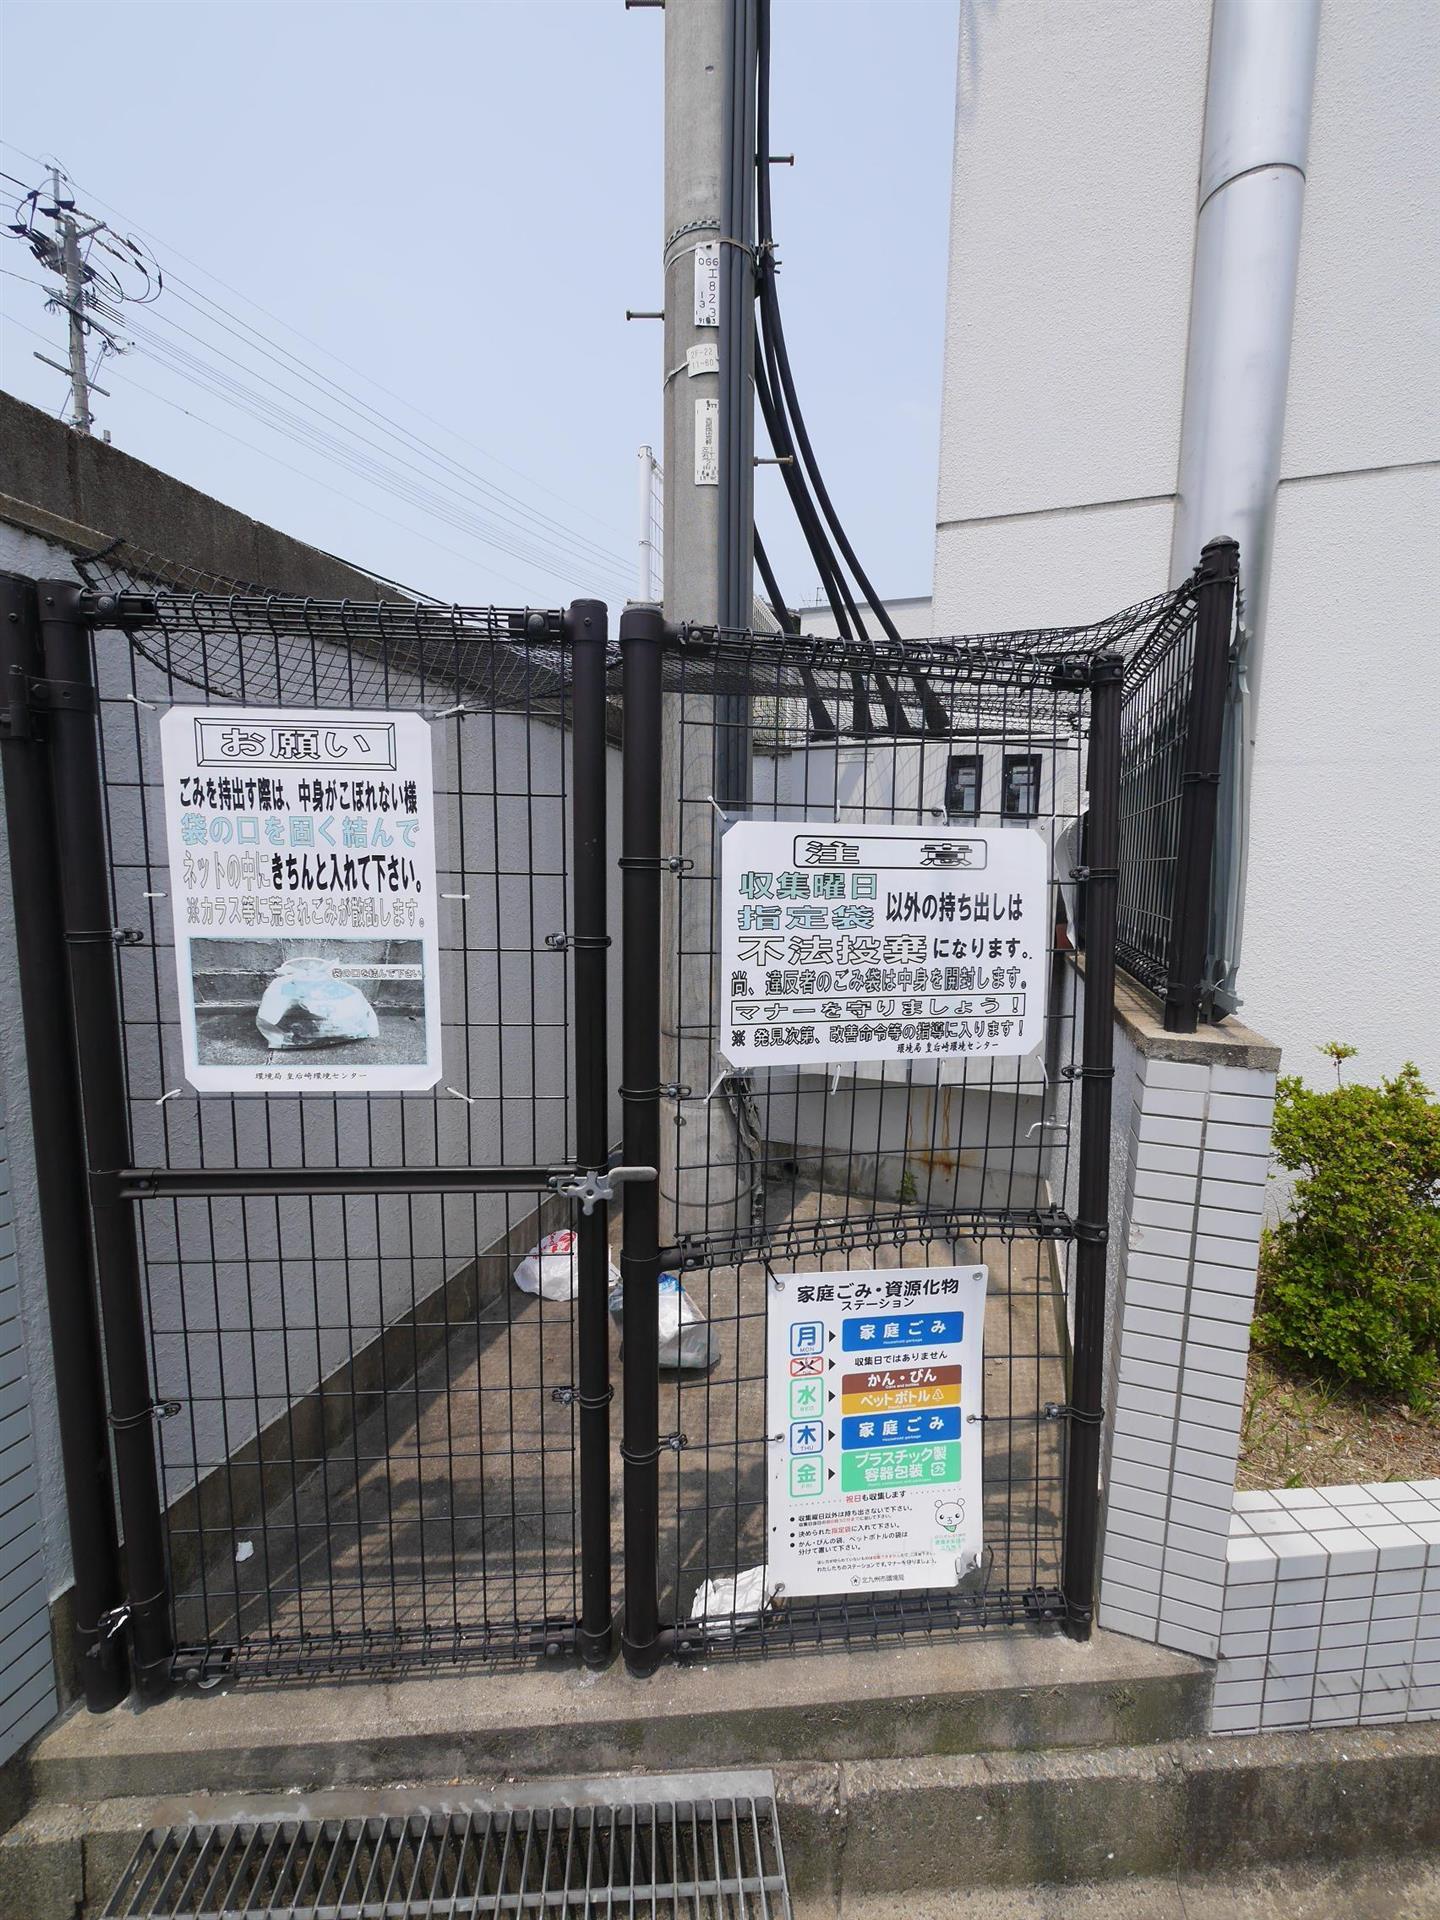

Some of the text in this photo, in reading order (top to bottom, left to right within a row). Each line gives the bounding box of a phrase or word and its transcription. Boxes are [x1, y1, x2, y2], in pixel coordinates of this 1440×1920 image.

[699, 258, 718, 266] 066
[220, 727, 370, 760] お願い
[180, 776, 418, 814] ごみを持出す際は、中身がこぼれない様
[182, 814, 420, 848] 袋の口を固く結んで
[804, 840, 973, 866] 注意
[183, 850, 422, 893] ネットの中にきちんと入れて下さい。
[739, 871, 877, 900] 収集曜日
[187, 896, 424, 929] ※カラス等に荒されごみが散乱します。
[886, 891, 1023, 922] 以外の持ち出しは
[738, 905, 874, 931] 指定袋
[731, 967, 1027, 997] 尚、違反者のごみ袋は中身を開封します。
[734, 997, 1020, 1021] マナーを守りましょう！
[797, 1278, 959, 1303] 家庭ごみ・資源化物
[842, 1297, 915, 1311] ステーション
[797, 1326, 816, 1347] 月
[860, 1318, 946, 1341] 家庭ごみ
[854, 1350, 948, 1367] 収集日ではありません
[868, 1368, 937, 1388] かん・びん
[797, 1386, 816, 1405] 水
[860, 1391, 930, 1407] ペットボトル
[797, 1426, 816, 1445] 木
[859, 1416, 944, 1438] 家庭ごみ
[855, 1446, 946, 1468] プラスチック製
[797, 1464, 816, 1482] 金
[865, 1464, 923, 1482] 容器包装
[846, 1489, 906, 1503] 祝日も収集します
